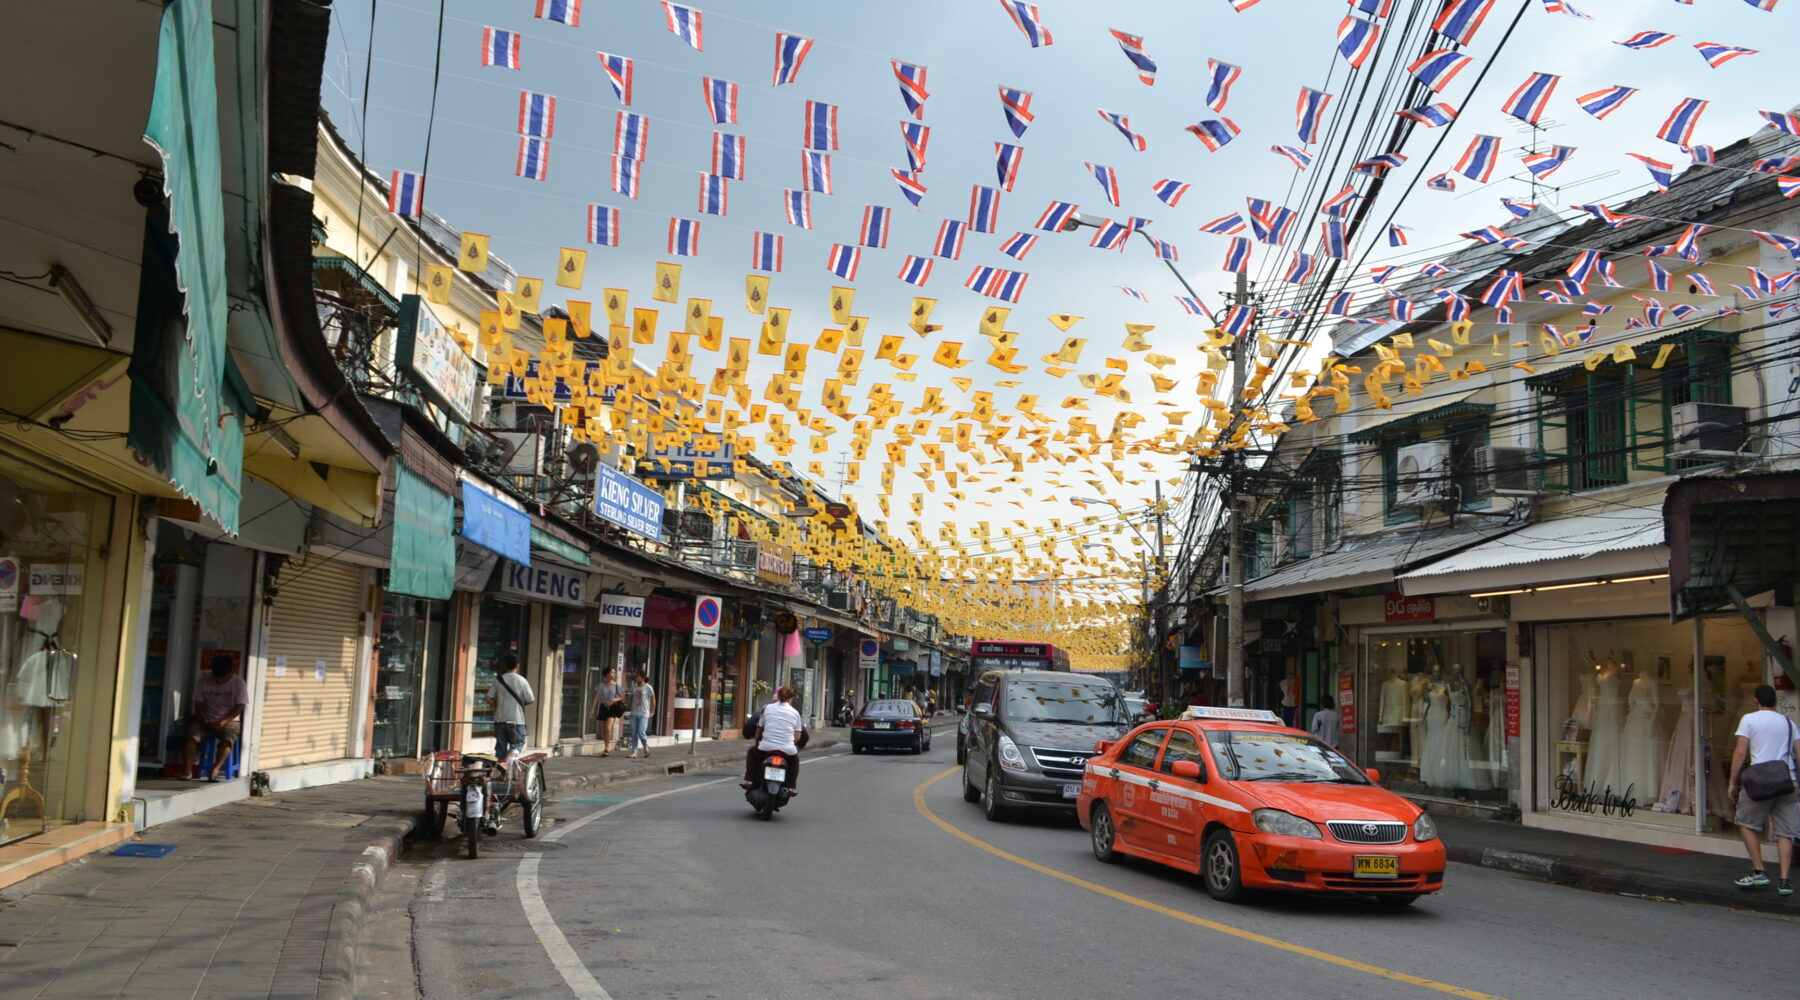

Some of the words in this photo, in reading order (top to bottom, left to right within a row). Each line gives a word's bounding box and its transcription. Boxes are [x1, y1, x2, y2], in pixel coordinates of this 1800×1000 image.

[601, 476, 630, 509] KIENG
[631, 491, 660, 523] SILVER
[600, 502, 626, 524] STERLING
[627, 514, 645, 532] SILVER
[509, 564, 580, 601] KIENG
[602, 603, 642, 618] KIENG
[1551, 774, 1600, 815] Bride
[1603, 784, 1618, 816] to
[1620, 782, 1637, 818] be
[1373, 858, 1395, 869] 6834
